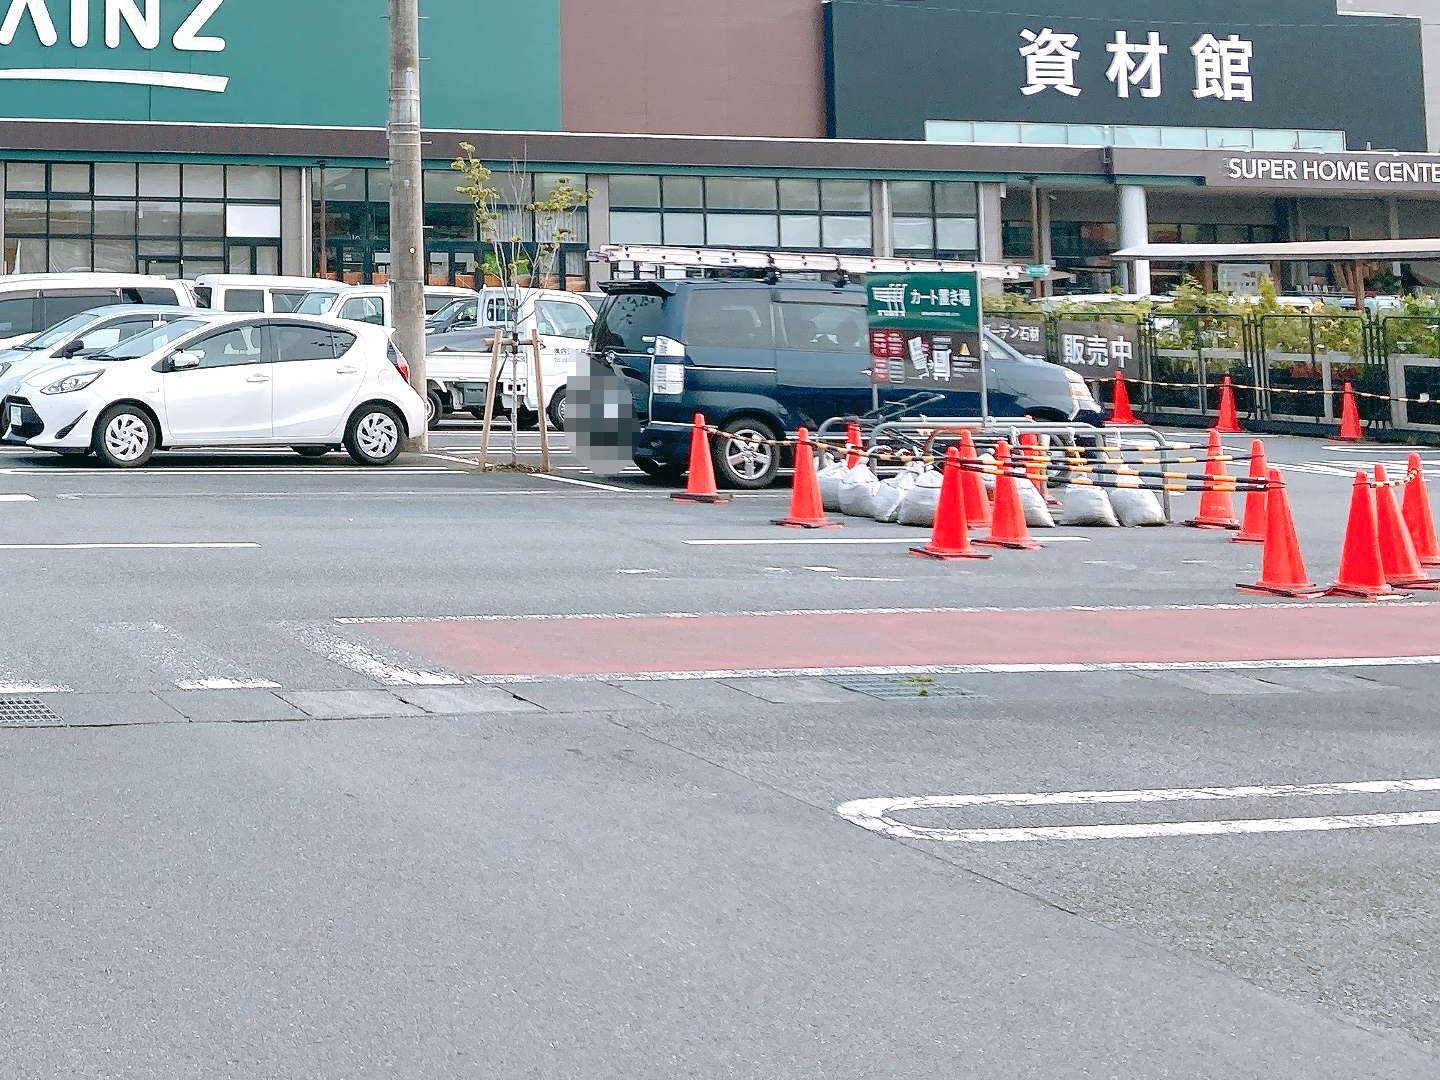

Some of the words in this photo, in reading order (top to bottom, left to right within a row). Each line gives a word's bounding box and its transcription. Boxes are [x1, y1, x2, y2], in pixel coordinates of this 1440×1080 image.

[1019, 27, 1253, 102] 資材館
[1229, 157, 1298, 180] SUPER
[1302, 160, 1370, 182] HOME
[1374, 161, 1440, 183] CENTE
[1062, 334, 1133, 369] 販売中
